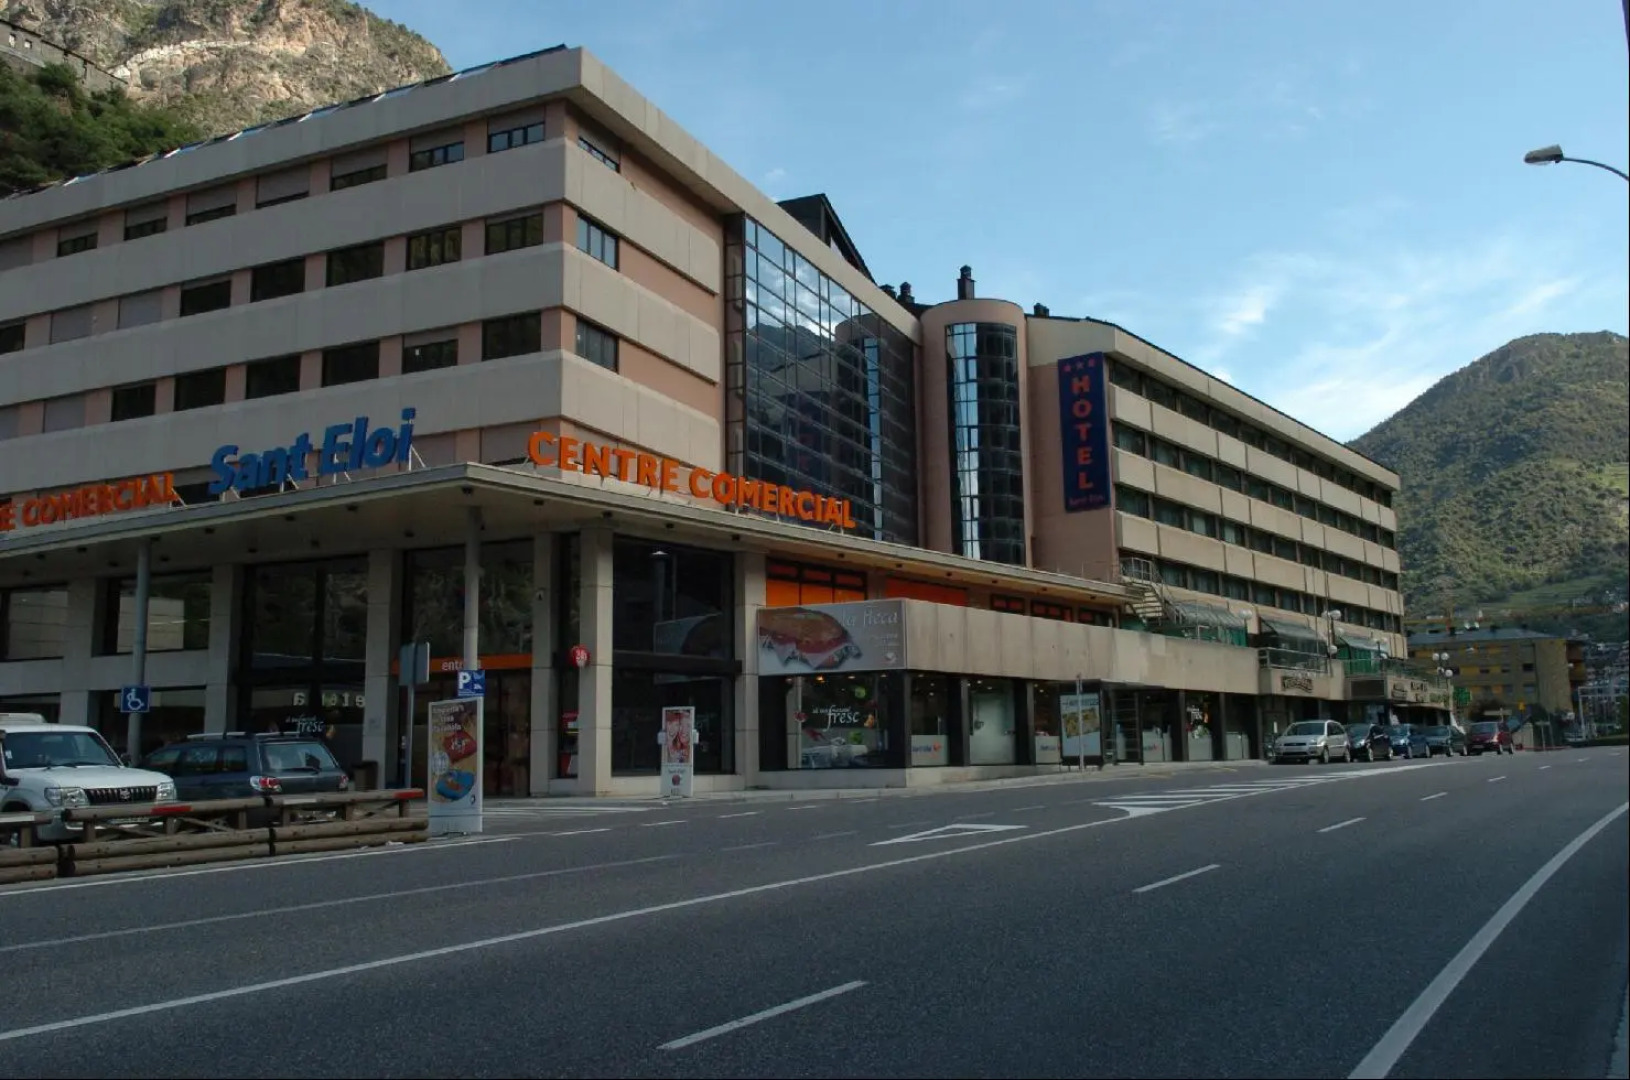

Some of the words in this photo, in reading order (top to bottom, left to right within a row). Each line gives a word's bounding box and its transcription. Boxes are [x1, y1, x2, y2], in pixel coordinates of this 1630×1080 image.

[208, 433, 313, 494] Sant
[320, 407, 416, 475] Eloi
[1070, 374, 1094, 492] HOTEL
[22, 472, 178, 527] COMERCIAL
[528, 431, 681, 492] CENTRE
[689, 467, 857, 529] COMERCIAL
[459, 672, 472, 690] P
[822, 704, 860, 732] fresc
